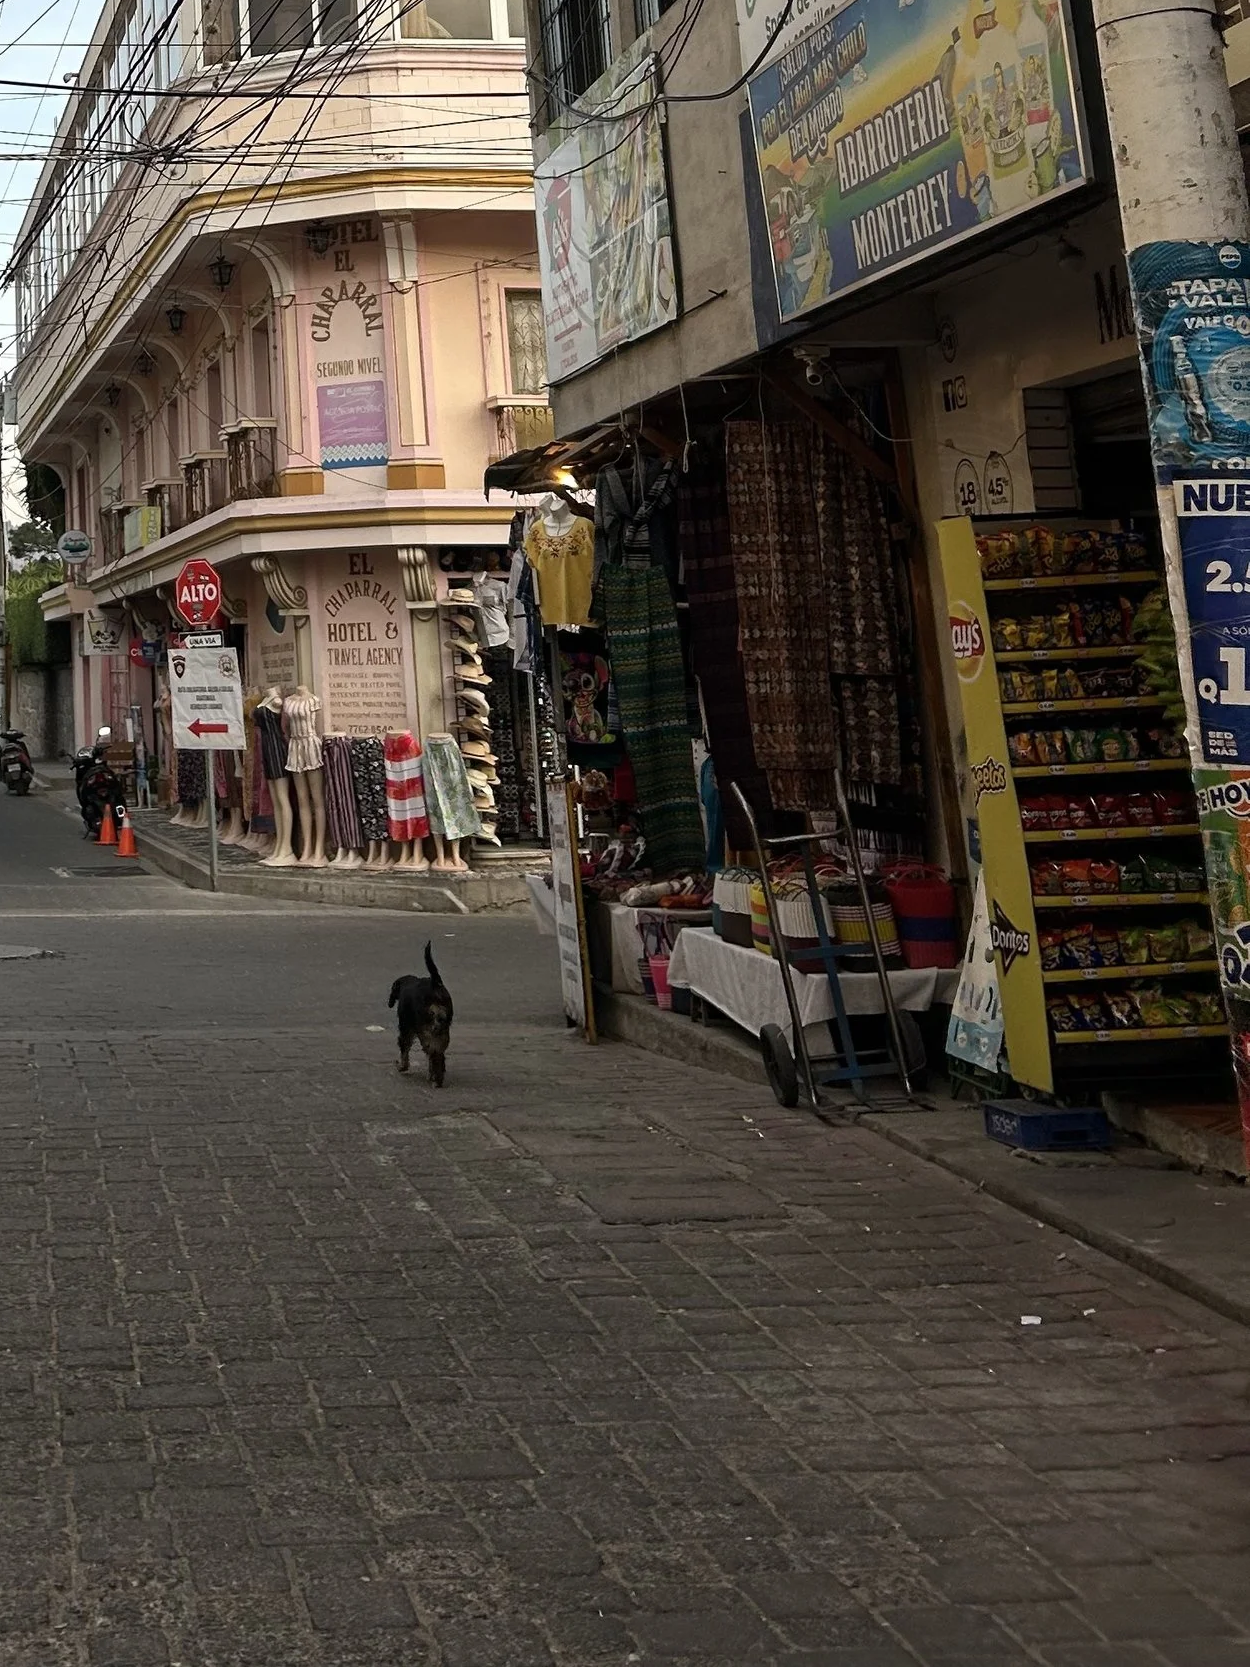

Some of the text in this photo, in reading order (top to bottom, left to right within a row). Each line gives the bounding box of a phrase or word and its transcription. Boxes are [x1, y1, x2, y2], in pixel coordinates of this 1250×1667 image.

[778, 99, 789, 123] EL
[836, 22, 866, 70] CHULO
[807, 87, 844, 144] MUNDO
[835, 80, 949, 192] ABARROTERIA
[852, 170, 952, 269] MONTERREY
[334, 251, 354, 272] EL
[311, 280, 384, 342] CHAPARRAL
[317, 357, 383, 378] SEGUNDO NIVEL
[348, 553, 374, 575] EL
[1205, 560, 1250, 593] 2.
[180, 584, 217, 604] ALTO
[324, 579, 398, 618] CHAPARRAL
[189, 636, 217, 646] UNA VIA
[327, 621, 398, 642] HOTEL &
[1232, 625, 1250, 635] SÓ
[327, 646, 403, 665] TRAVEL AGENCY
[974, 762, 1006, 789] eetos
[992, 925, 1029, 952] Doritos
